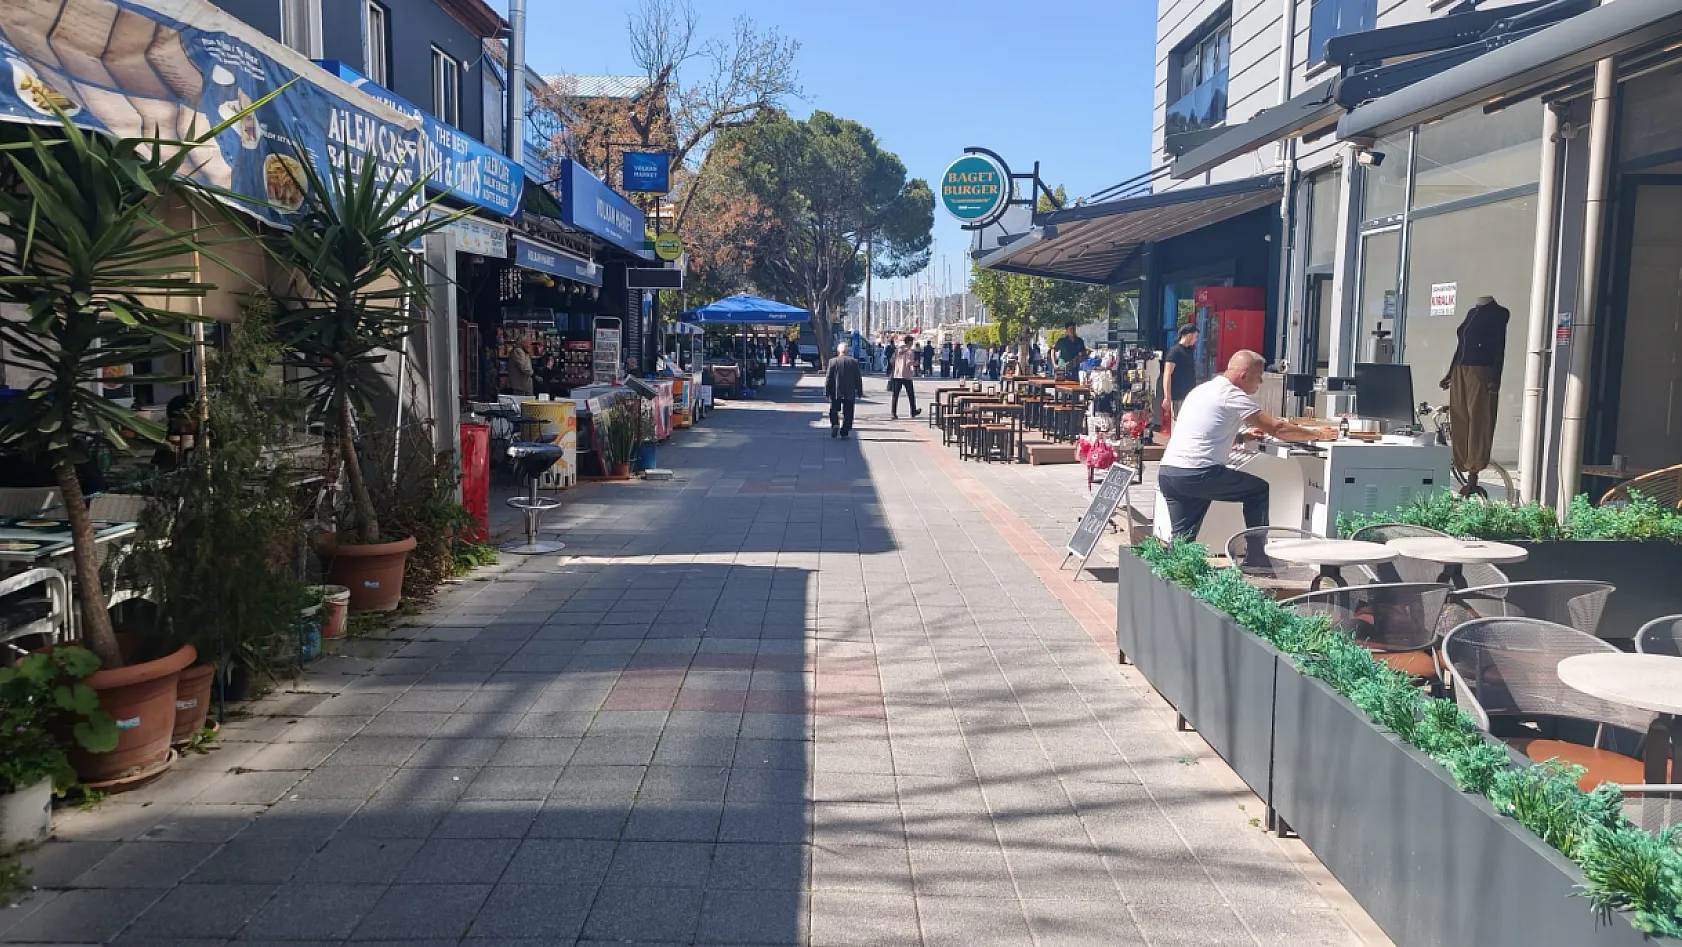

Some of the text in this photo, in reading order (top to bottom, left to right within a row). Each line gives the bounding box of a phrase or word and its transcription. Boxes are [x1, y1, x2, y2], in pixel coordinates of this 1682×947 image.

[435, 125, 468, 156] THE BEST
[445, 157, 452, 187] &
[456, 156, 481, 199] CHIPS
[948, 171, 995, 183] BAGET
[944, 184, 998, 195] BURGER
